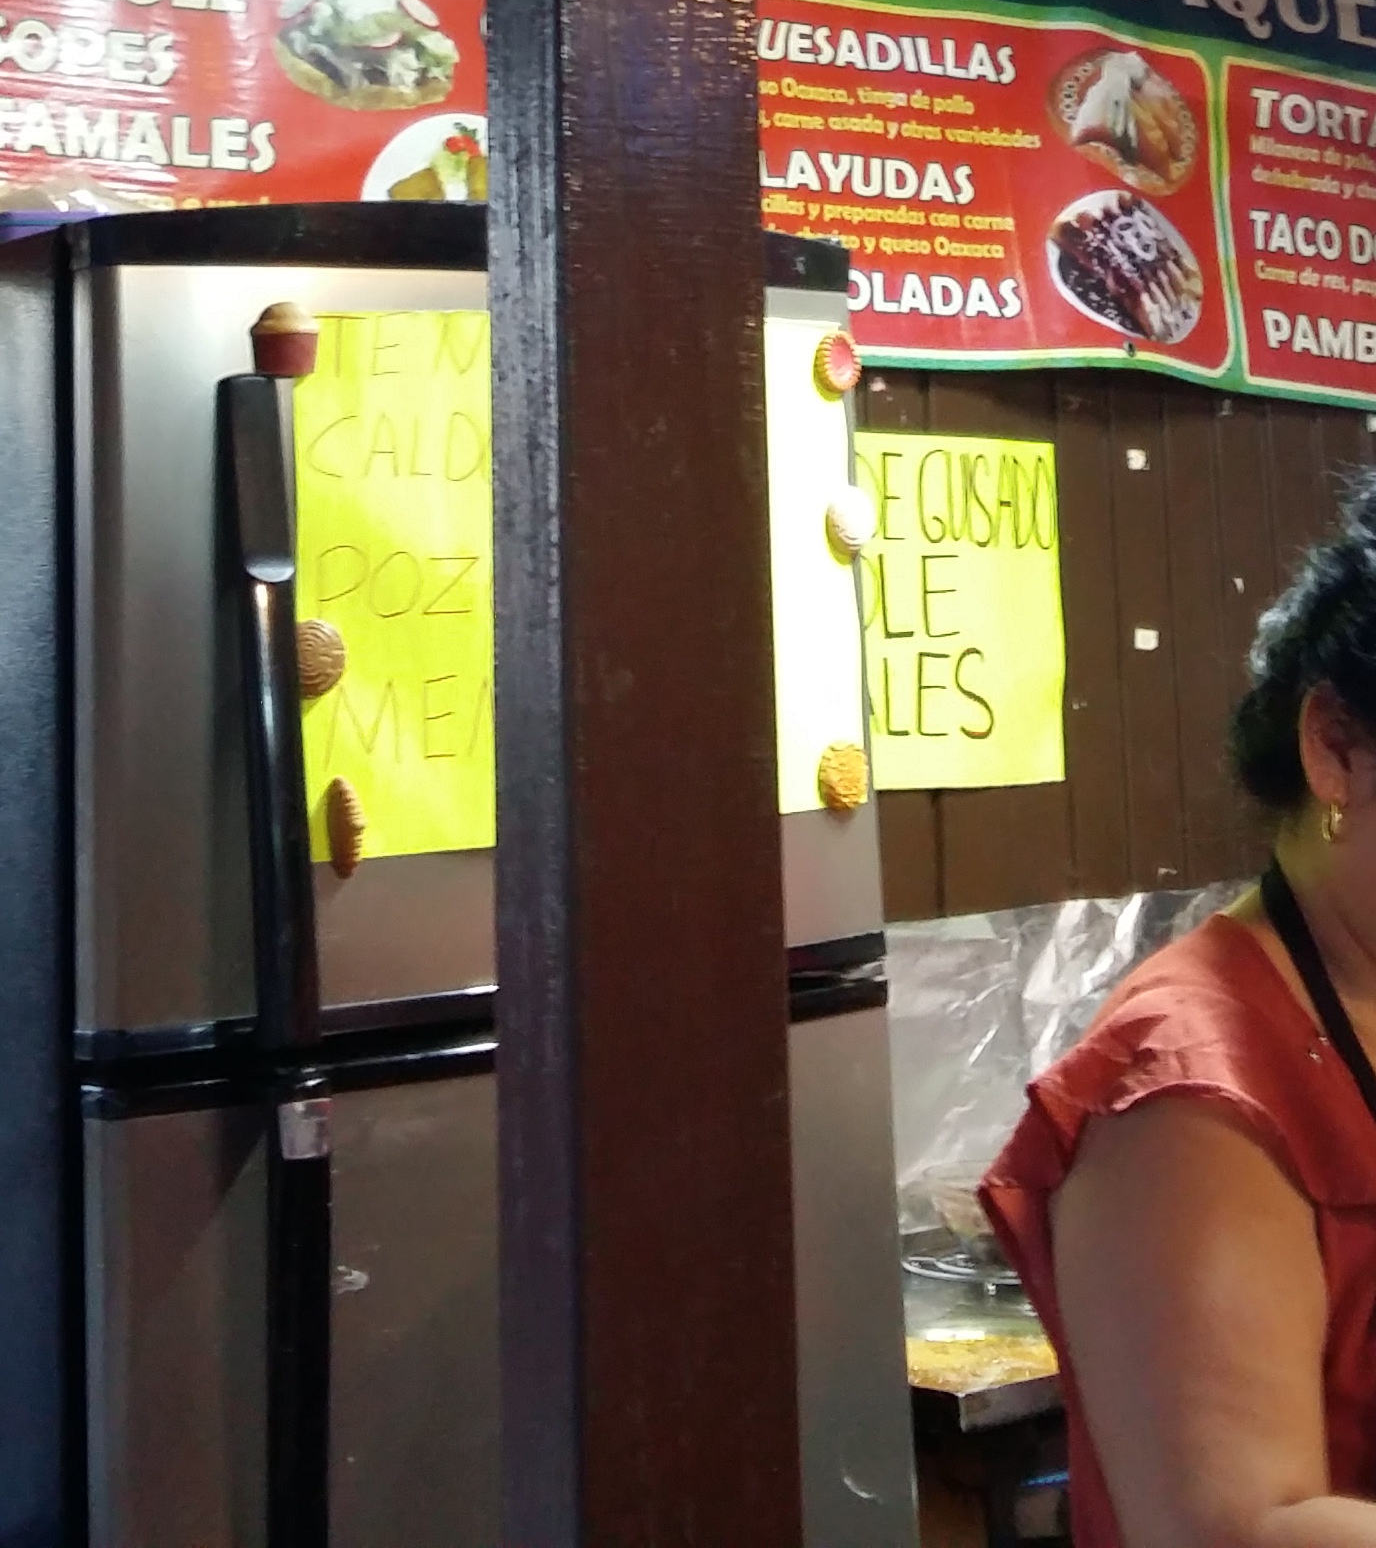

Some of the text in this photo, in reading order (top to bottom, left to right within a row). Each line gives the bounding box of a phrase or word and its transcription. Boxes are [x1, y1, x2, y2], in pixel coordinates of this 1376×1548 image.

[756, 18, 1017, 85] UESADILLAS
[758, 149, 975, 205] LAYUDAS
[823, 204, 926, 226] preparadas
[928, 209, 961, 228] con
[963, 215, 1015, 232] carne
[1249, 209, 1342, 262] TACO
[878, 236, 931, 255] queso
[846, 268, 1023, 319] OLADAS
[307, 412, 488, 482] CALD
